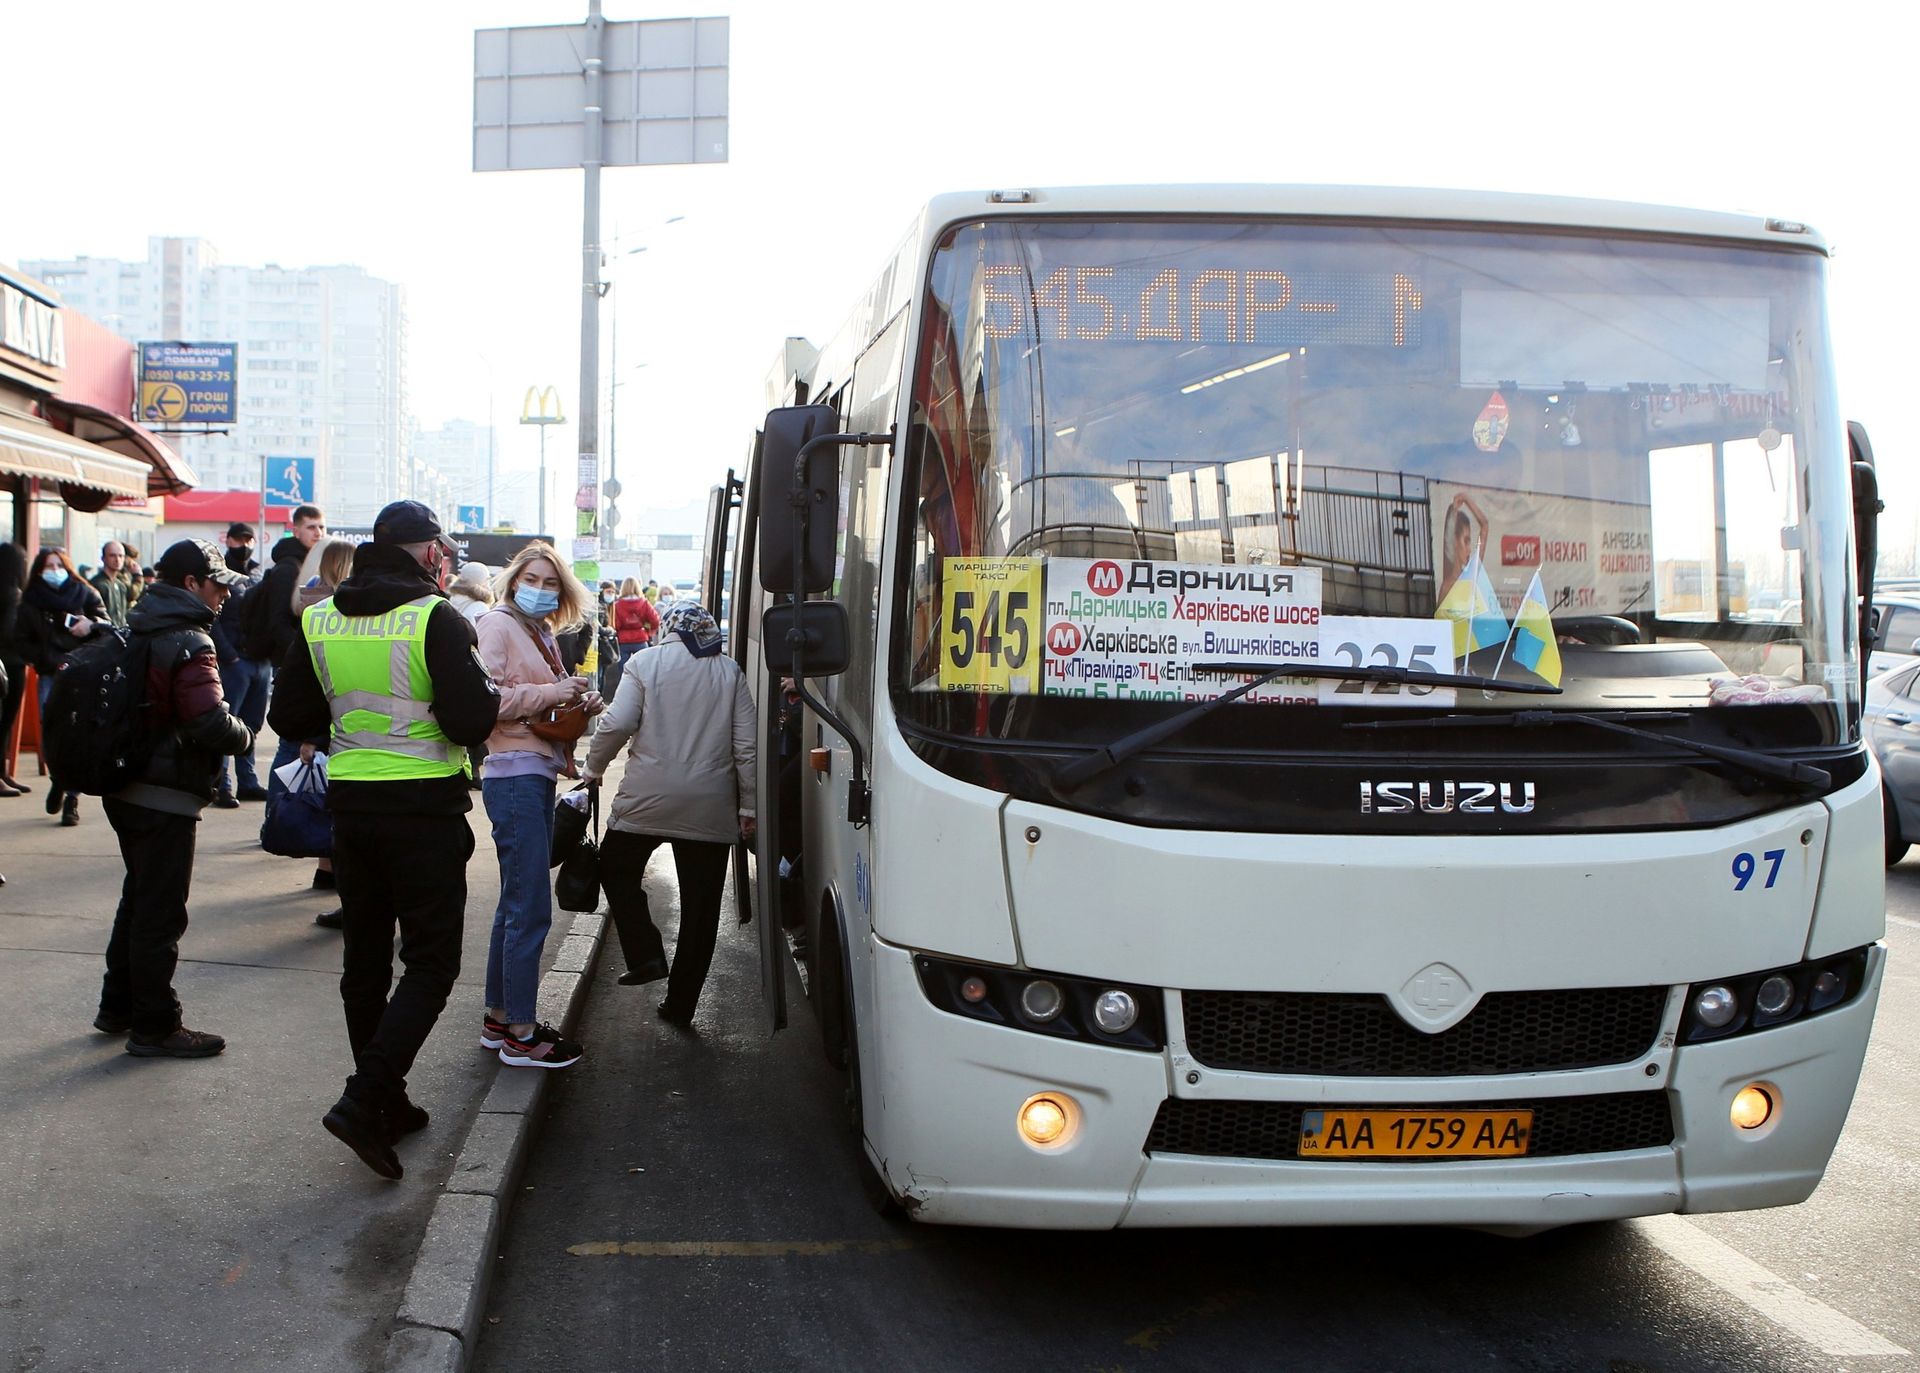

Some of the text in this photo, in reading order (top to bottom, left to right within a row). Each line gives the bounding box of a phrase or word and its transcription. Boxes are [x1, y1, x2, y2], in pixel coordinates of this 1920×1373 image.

[190, 391, 228, 402] ГРОШІ
[953, 563, 1029, 571] МАРШРУТНЕ
[1127, 562, 1293, 597] Дарниця
[309, 610, 419, 638] ПОЛІЦІЯ
[1069, 591, 1168, 623] Дарницька
[1172, 594, 1269, 627] Харківське
[1274, 605, 1320, 625] шосе
[950, 590, 1029, 669] 545
[1082, 624, 1177, 659] Харківська
[1204, 631, 1319, 658] Вишняківська
[1335, 642, 1436, 697] 225
[948, 683, 1004, 691] ВАРТІСТЬ
[1360, 781, 1535, 813] ISUZU
[1732, 848, 1786, 891] 97
[1303, 1140, 1317, 1149] UA
[1325, 1118, 1521, 1149] AA 1759 AA
